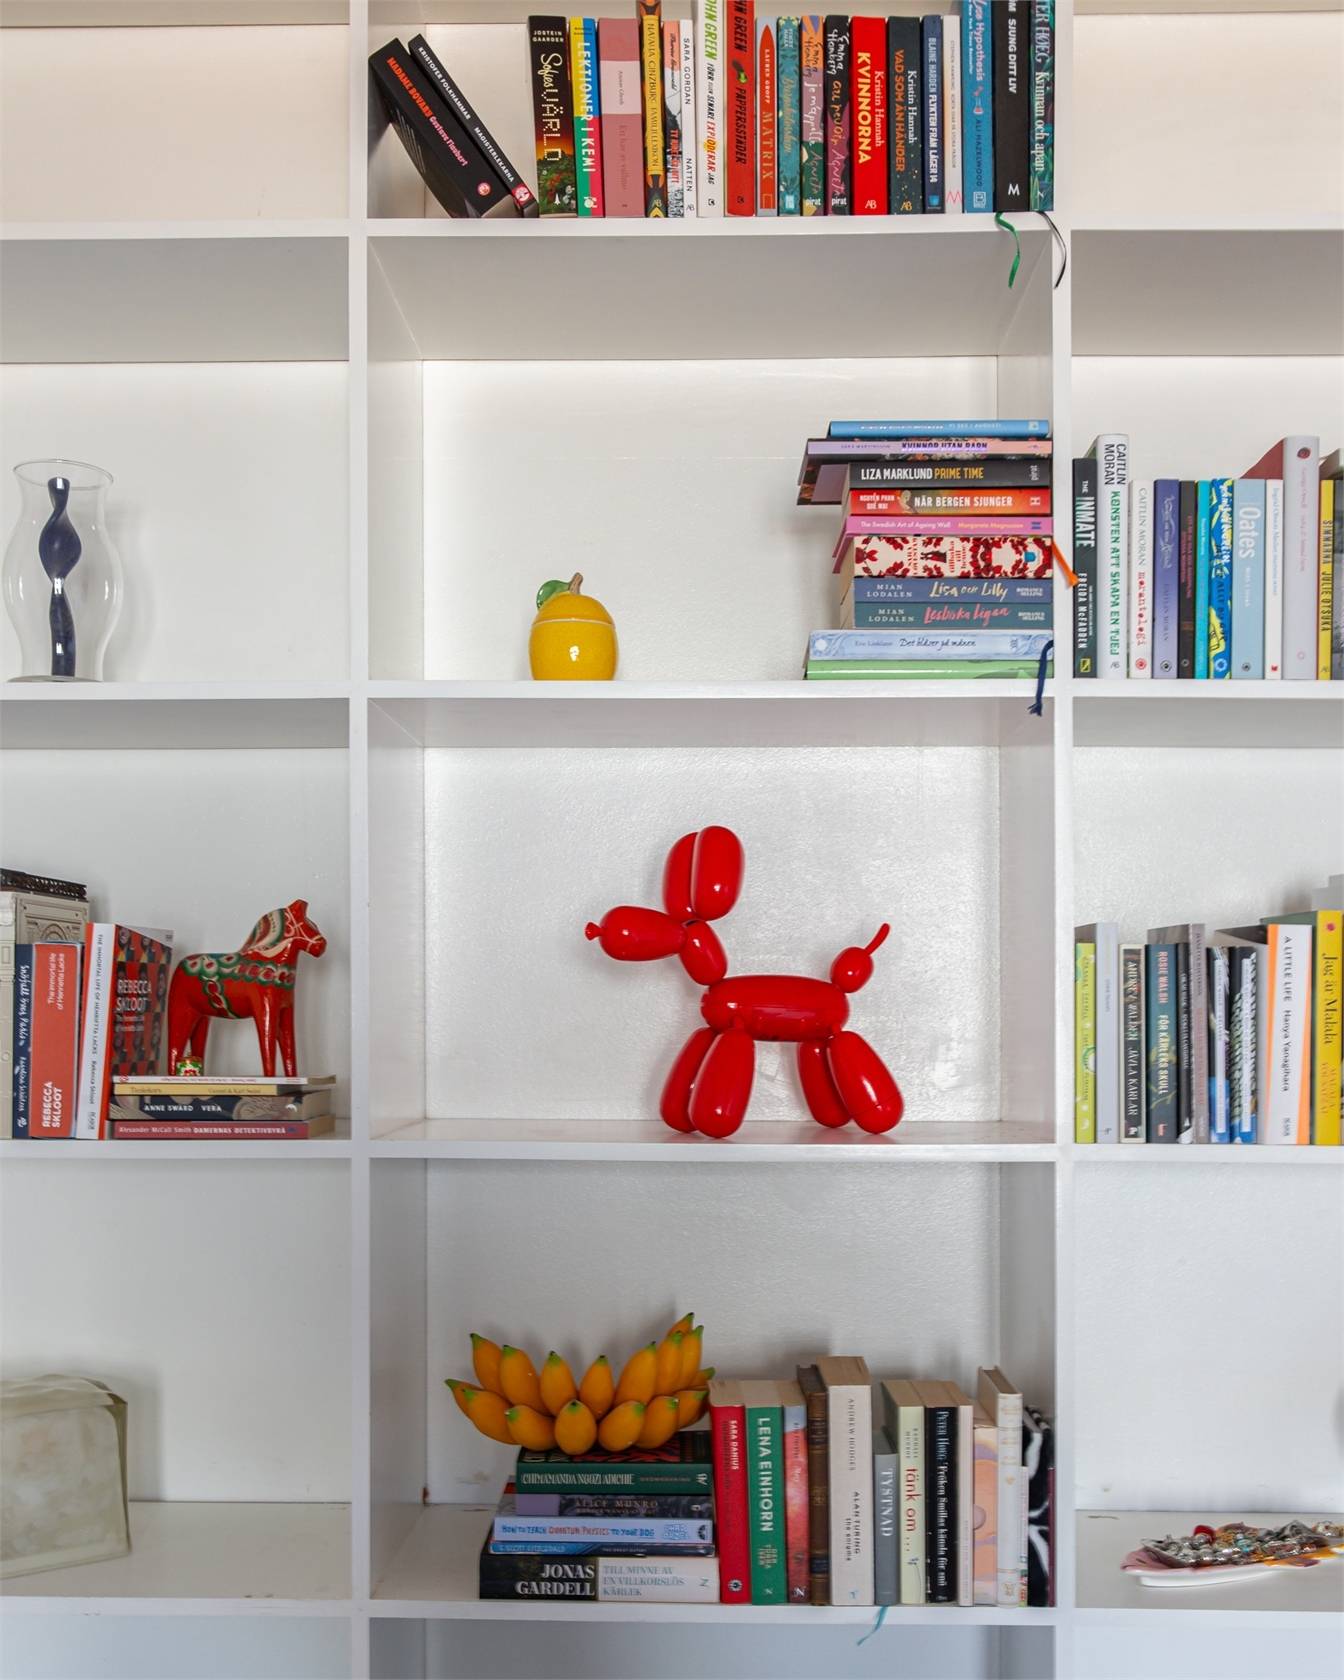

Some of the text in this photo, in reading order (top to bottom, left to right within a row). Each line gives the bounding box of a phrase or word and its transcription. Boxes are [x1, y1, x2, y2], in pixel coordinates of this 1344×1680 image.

[704, 22, 717, 61] GREEN
[734, 16, 747, 52] GREEN
[975, 22, 985, 81] Hypothesis
[1035, 27, 1051, 63] HØEG
[538, 53, 563, 87] Sofies
[928, 38, 937, 92] BLAINE HARDEN
[1008, 19, 1017, 93] SJUNG DITT LIV
[577, 41, 592, 121] LEKTIONER
[684, 66, 692, 105] GORDAN
[387, 56, 469, 166] MADAME BOVARY Gustave Flaubert
[417, 47, 514, 182] KRISTOFER FOLKHAMMAR MAGISTERLEKARNA
[541, 88, 564, 161] VÄRLD
[735, 87, 747, 165] PAPPERSSTÄDER
[857, 52, 872, 164] KVINNORNA
[874, 71, 884, 147] Kristin Hannah
[894, 49, 907, 171] VAD SOM ÄN HÄNDER
[906, 70, 917, 144] Kristin Hannah
[928, 94, 938, 126] FLYKTEN
[1031, 72, 1050, 171] Kvinnan och apan
[581, 137, 596, 172] KEMI
[762, 112, 773, 180] MATRIX
[929, 127, 938, 147] FRÅN
[685, 158, 693, 192] NATTEN
[929, 175, 938, 183] 14
[975, 134, 983, 187] HAZELWOOD
[861, 468, 933, 480] LIZA MARKLUND
[934, 467, 985, 479] PRIME TIME
[1104, 444, 1115, 486] MORAN
[1116, 443, 1126, 486] CAITLIN
[914, 495, 1013, 507] NÄR BERGEN SJUNGER
[1076, 496, 1095, 548] INMATE
[1138, 487, 1147, 566] CAITLIN MORAN
[1239, 507, 1262, 558] Oates
[1110, 547, 1120, 568] ATT
[1321, 519, 1332, 632] SIMMARNA JULIE OTSUKA
[930, 582, 958, 597] Lisa
[981, 582, 1009, 602] Lilly
[1078, 573, 1087, 649] FREIDA McFADDEN
[1110, 572, 1120, 608] SKAPA
[1135, 572, 1147, 646] morantologi
[924, 605, 971, 624] Lesbiska
[1110, 611, 1120, 625] EN
[1110, 629, 1120, 656] TJEJ
[1158, 951, 1168, 1004] ROSIE WALSH
[1284, 946, 1292, 979] LITTLE
[94, 993, 101, 1001] OF
[116, 979, 153, 996] REBECCA
[116, 997, 149, 1013] SKLOOT
[1284, 981, 1292, 1002] LIFE
[1322, 953, 1339, 1045] Jag är Malala
[1157, 1014, 1170, 1095] FÖR KÄRLEKS SKULL
[1281, 1010, 1292, 1092] Hanya Yanagihara
[1127, 1047, 1139, 1116] JÄVLA KARLAR
[41, 1081, 54, 1128] REBECCA
[52, 1087, 63, 1128] SKLOOT
[847, 1398, 856, 1471] ANDREW HODGES
[937, 1410, 949, 1435] PETER
[729, 1419, 739, 1470] SARA DANIUS
[522, 1473, 576, 1485] CHIMAMANDA
[577, 1473, 602, 1485] NGOZI
[602, 1473, 635, 1485] ADICHIE
[756, 1418, 773, 1532] LENA EINHORN
[881, 1468, 893, 1537] TYSTNAD
[906, 1468, 922, 1532] tänk om
[844, 1533, 852, 1561] enigma
[853, 1519, 861, 1555] TURING
[937, 1496, 949, 1586] Smillas känsla för snö
[515, 1581, 596, 1596] GARDELL
[540, 1564, 596, 1580] JONAS
[602, 1565, 673, 1575] TILL MINNE AV
[602, 1575, 685, 1586] EN VILLKORSLÖS
[602, 1586, 642, 1596] KÄRLEK
